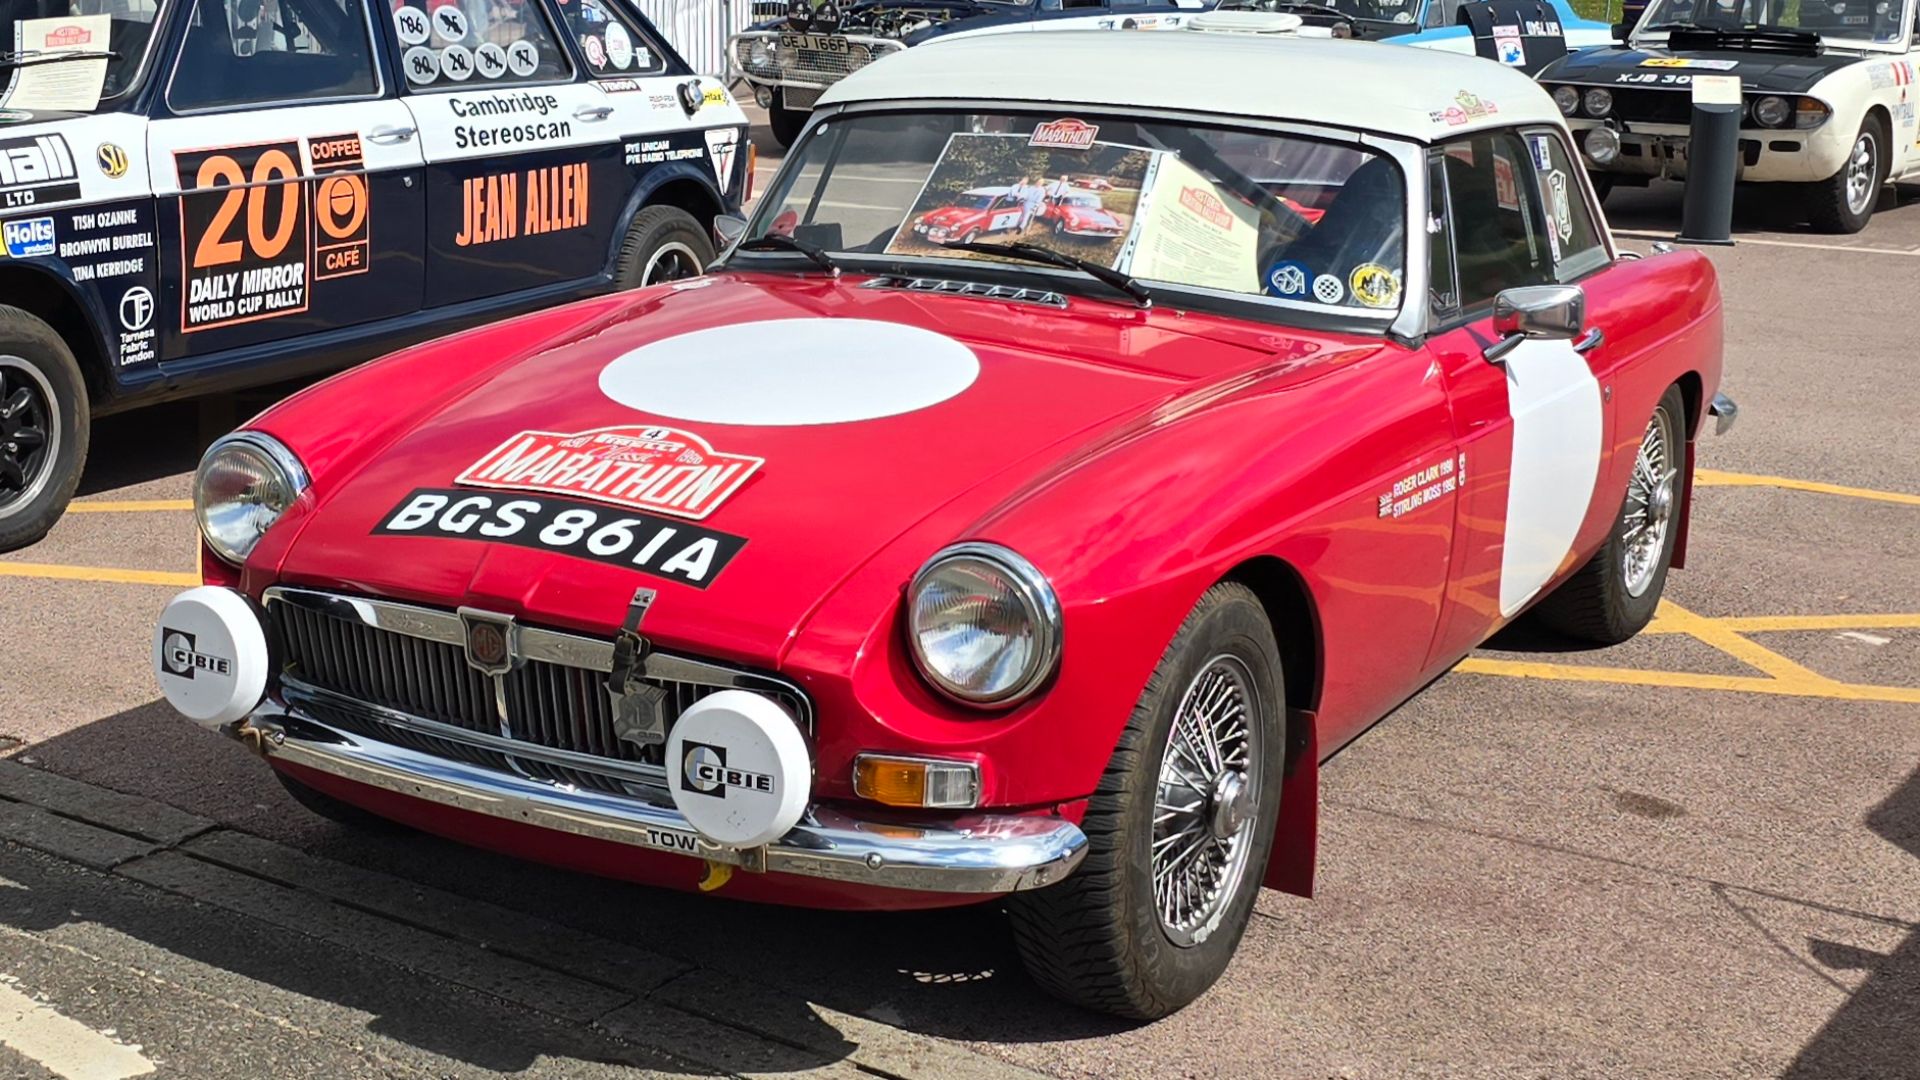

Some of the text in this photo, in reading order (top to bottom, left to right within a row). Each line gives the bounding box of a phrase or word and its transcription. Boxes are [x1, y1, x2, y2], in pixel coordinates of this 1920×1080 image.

[781, 35, 846, 51] GEJ 166F
[1616, 73, 1658, 83] XJB
[1661, 75, 1693, 84] 30
[449, 93, 559, 118] Cambridge
[454, 120, 572, 149] Stereoscan
[1035, 125, 1095, 145] MARATHON
[98, 143, 127, 176] SU
[311, 138, 362, 160] COFFEE
[642, 152, 666, 163] RADIO
[666, 148, 704, 161] TELEPHONE
[6, 190, 36, 207] LTD
[193, 149, 300, 269] 20
[455, 162, 590, 247] JEAN ALLEN
[72, 209, 137, 231] TISH OZANNE
[6, 221, 53, 245] Holts
[60, 232, 153, 258] BRONWYN BURRELL
[72, 258, 143, 282] TINA KERRIDGE
[326, 248, 359, 270] CAFÉ
[190, 262, 304, 304] DAILY MIRROR
[189, 289, 303, 323] WORLD CUP RALLY
[121, 340, 148, 354] Fabric
[121, 351, 155, 366] London
[478, 437, 743, 507] MARATHON
[1393, 474, 1417, 498] ROGER
[1417, 464, 1440, 486] CLARK
[1393, 491, 1422, 518] STIRLING
[1423, 483, 1441, 503] MOSS
[386, 495, 719, 581] BGS 861A
[174, 650, 228, 673] CIBIE
[648, 830, 696, 850] TOW
